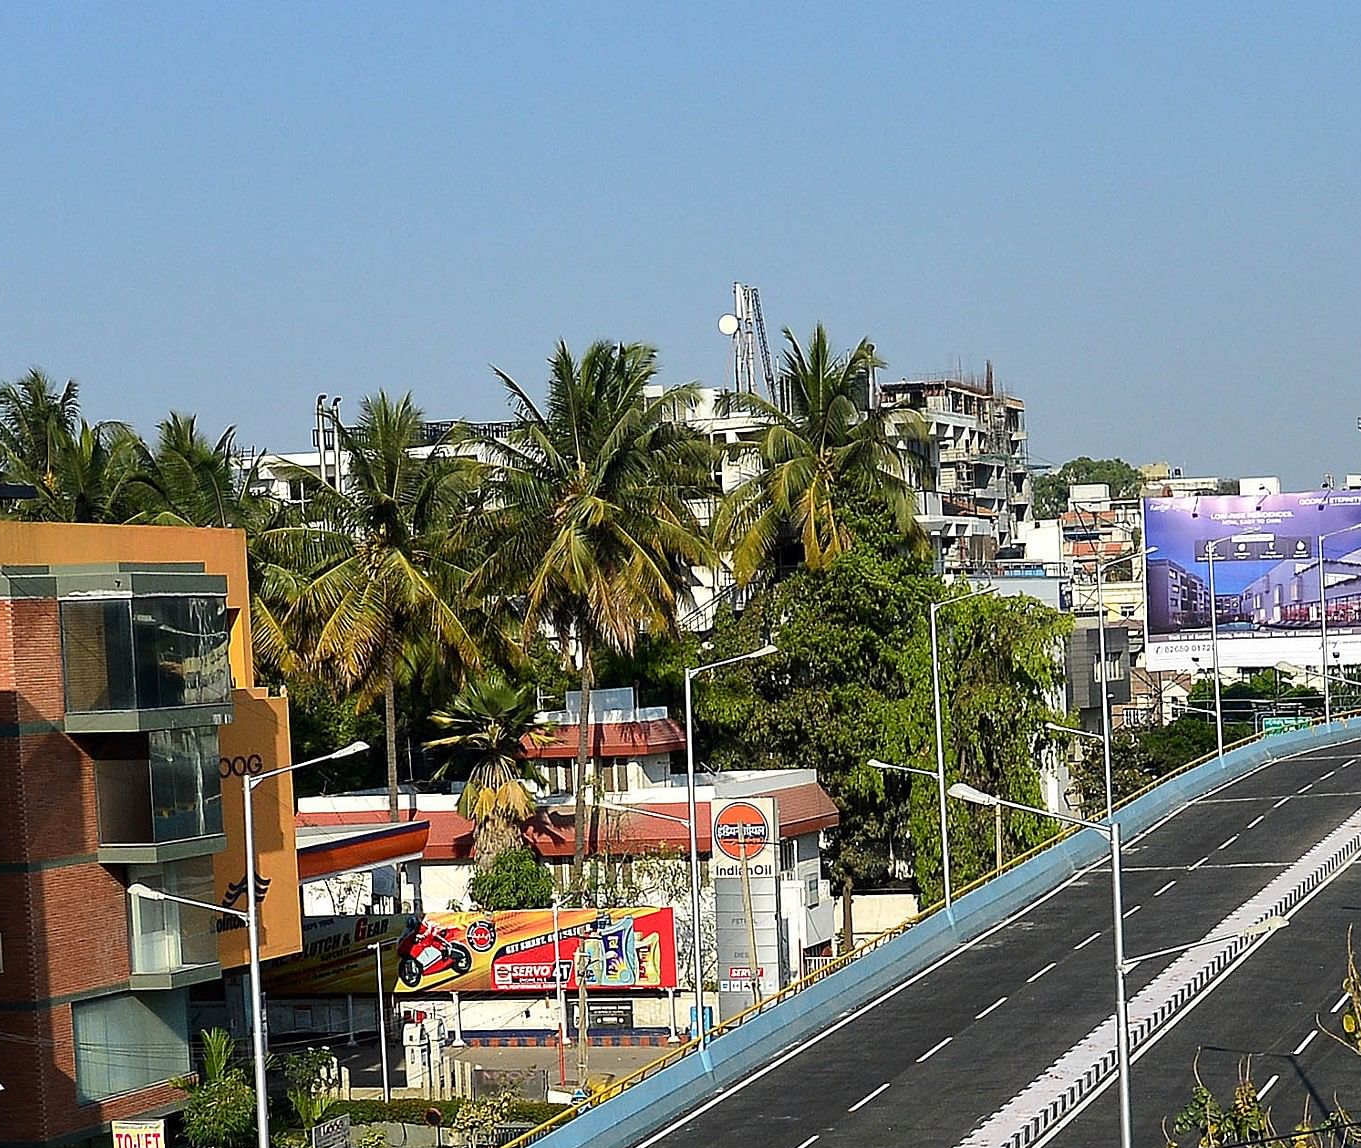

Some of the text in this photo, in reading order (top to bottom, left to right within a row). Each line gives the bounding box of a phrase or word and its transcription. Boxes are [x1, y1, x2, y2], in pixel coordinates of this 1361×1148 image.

[300, 934, 342, 958] LUTCH
[512, 965, 551, 977] SERVO
[731, 968, 761, 977] SERO
